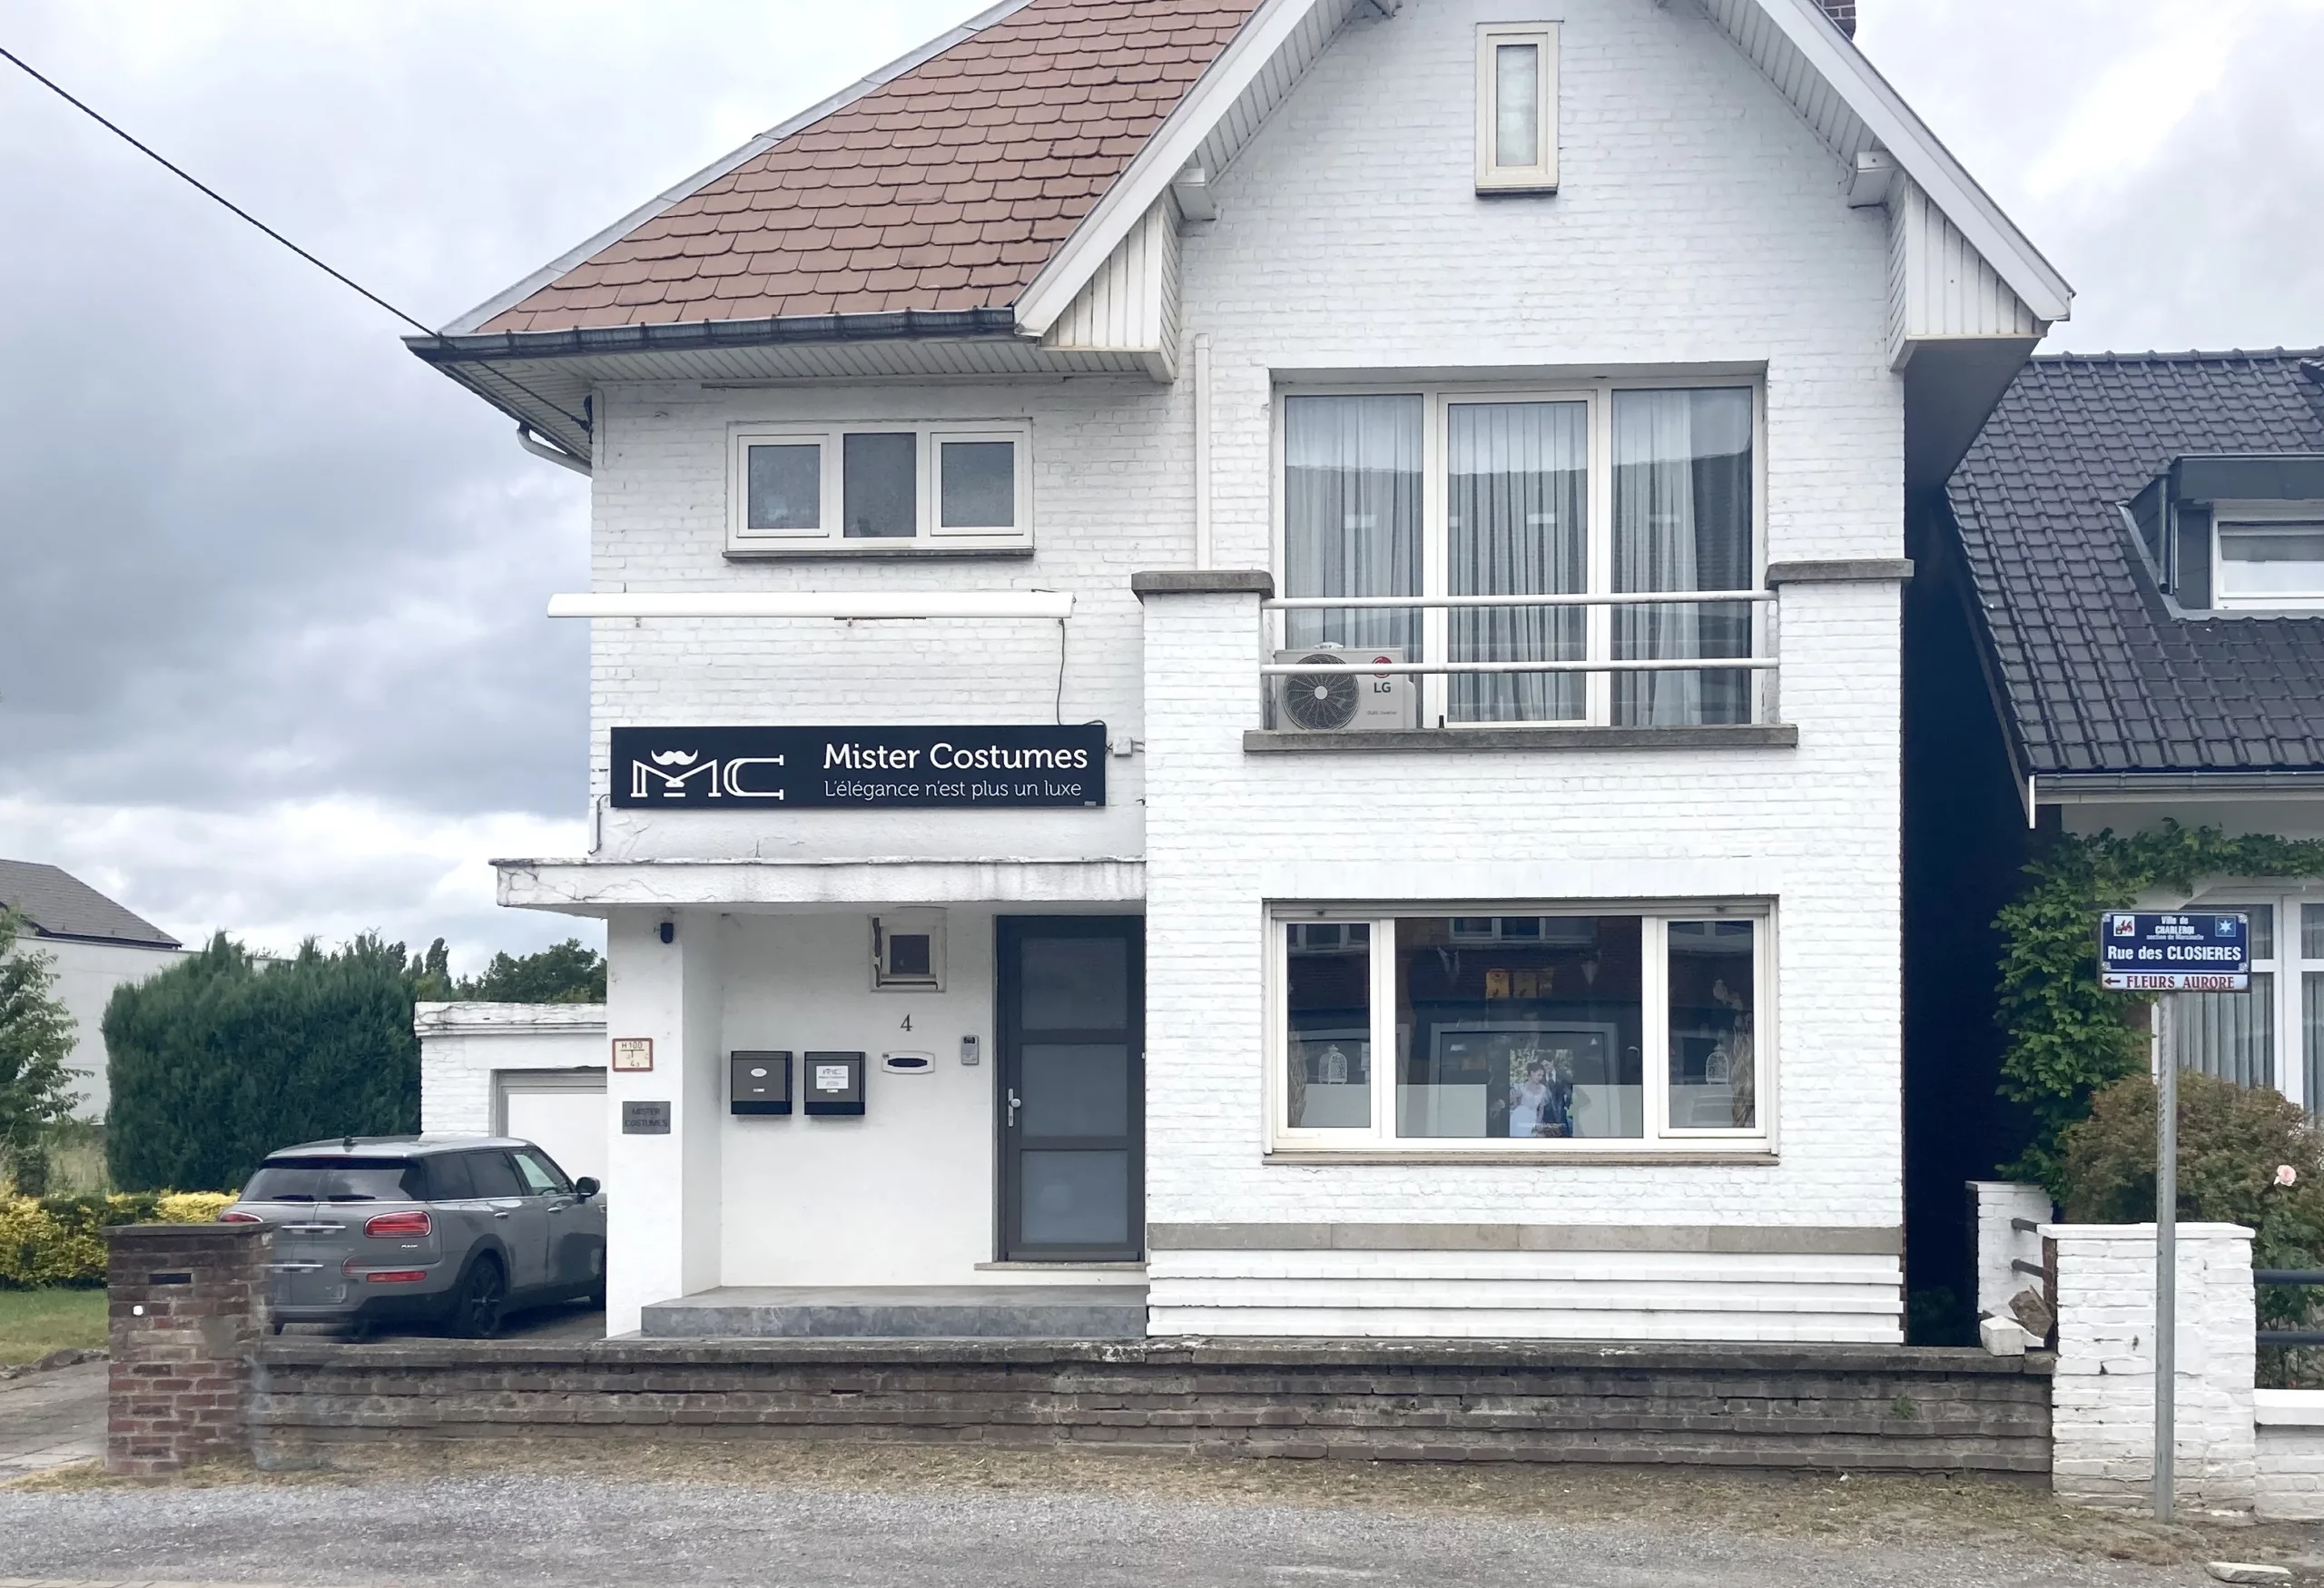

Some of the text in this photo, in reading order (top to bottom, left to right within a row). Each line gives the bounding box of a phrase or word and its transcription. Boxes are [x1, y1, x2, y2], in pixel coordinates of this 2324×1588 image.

[1374, 682, 1392, 694] LG
[822, 743, 1088, 769] Mister Costumes
[630, 755, 784, 801] MC
[824, 780, 1082, 801] L'élégance n'est plus un luxe
[2107, 945, 2241, 961] Rue des CLOSIERES
[2126, 975, 2234, 989] FLEURS AURORE
[900, 1013, 913, 1031] 4
